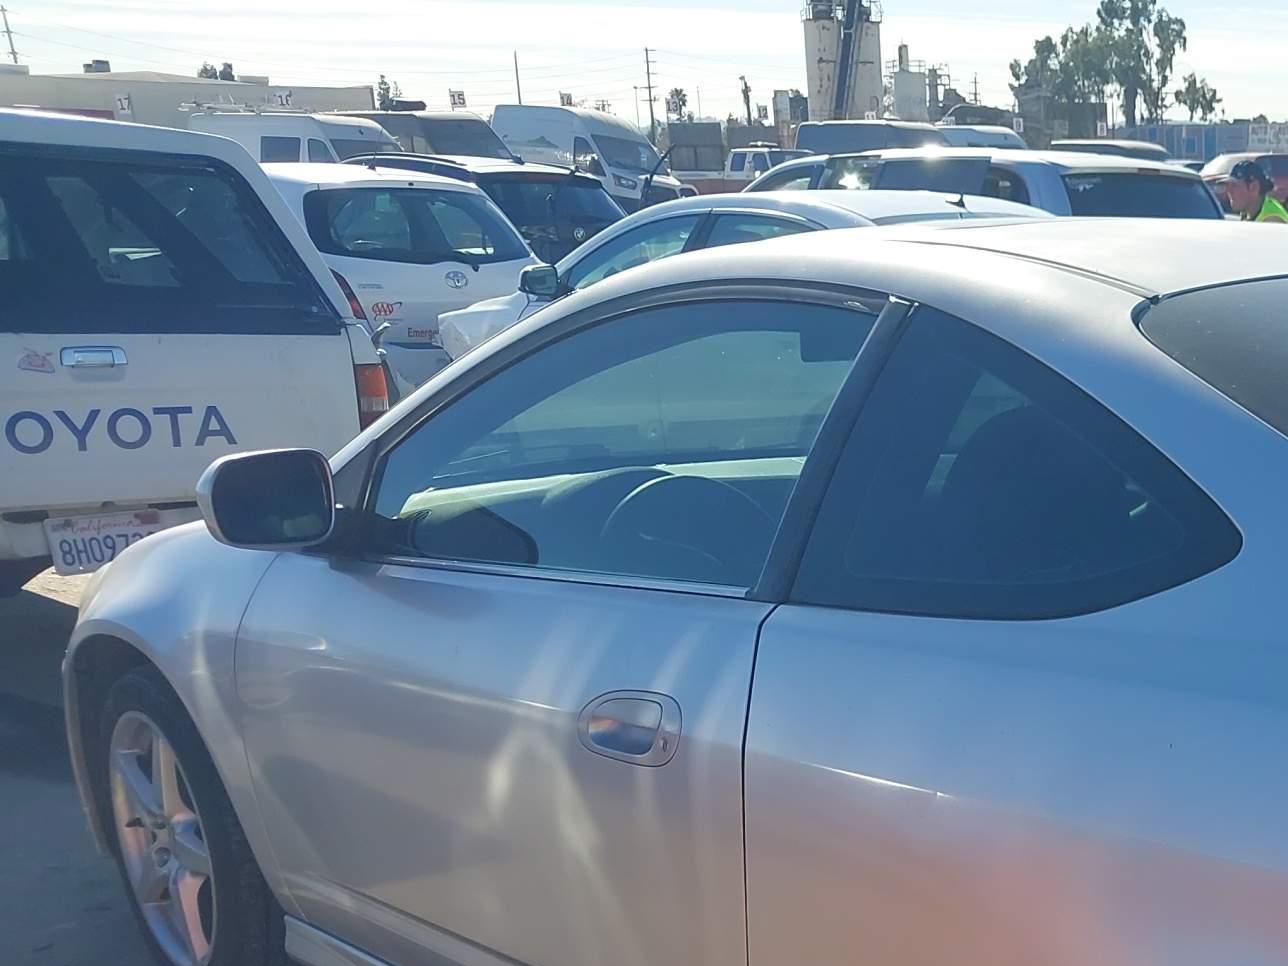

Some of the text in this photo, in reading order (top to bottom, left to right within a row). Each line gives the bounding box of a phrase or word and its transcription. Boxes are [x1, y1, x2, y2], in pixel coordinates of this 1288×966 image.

[450, 93, 466, 105] 15
[666, 101, 679, 113] 13
[5, 405, 238, 454] OYOTA
